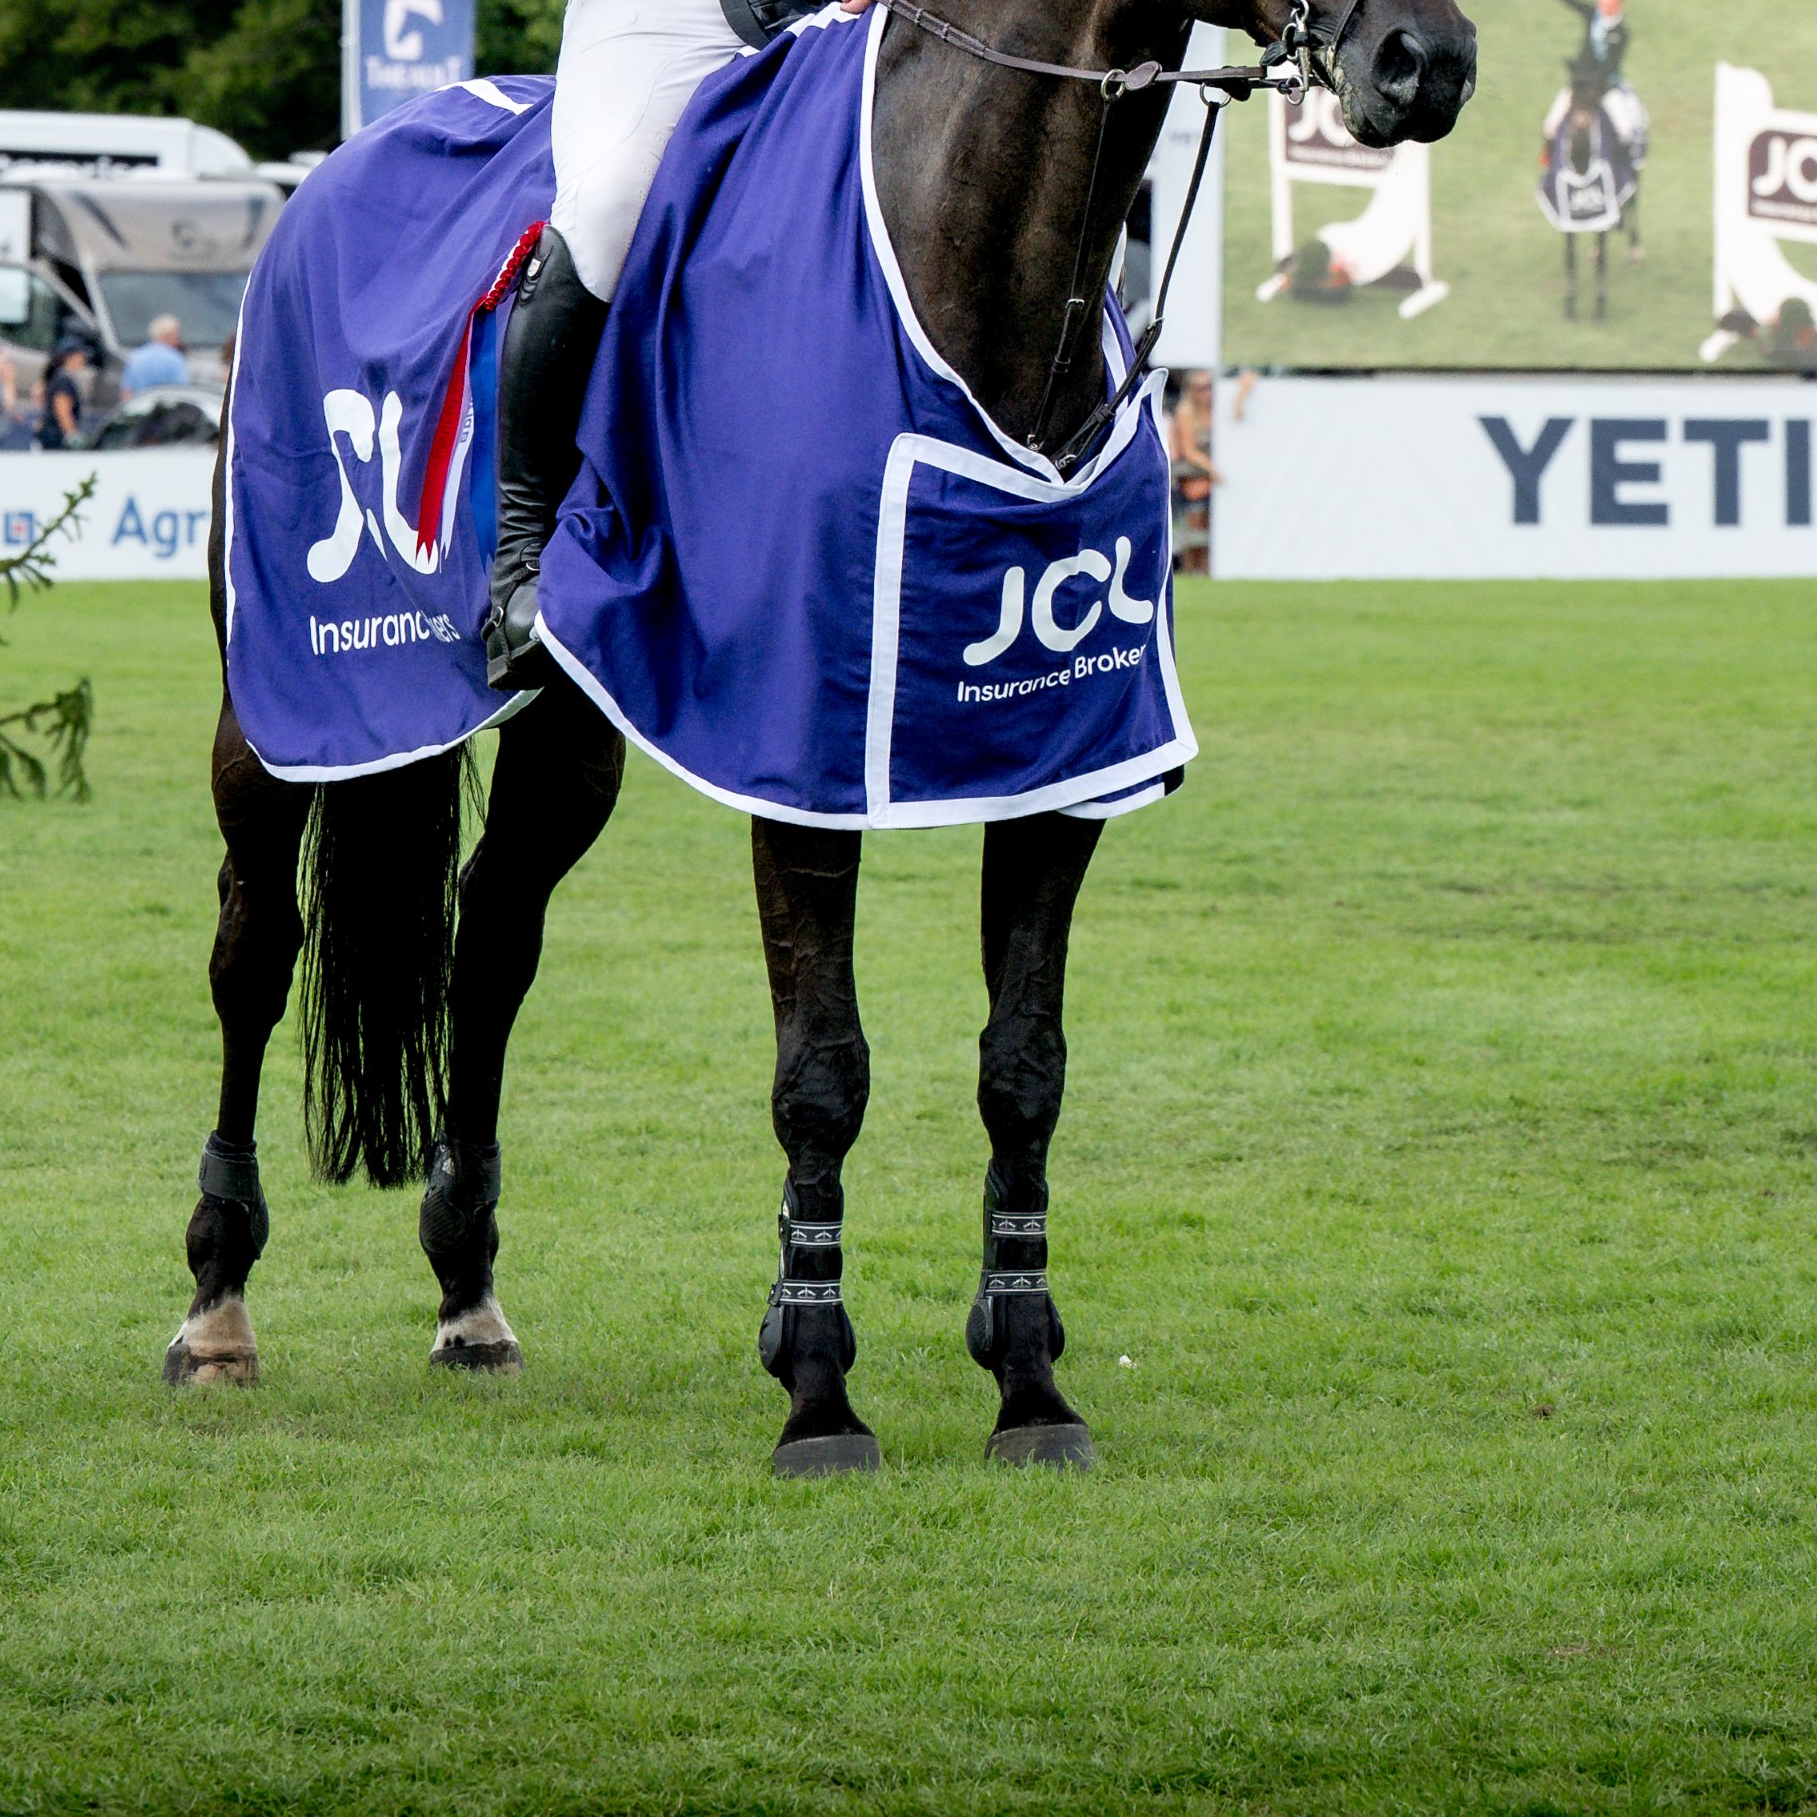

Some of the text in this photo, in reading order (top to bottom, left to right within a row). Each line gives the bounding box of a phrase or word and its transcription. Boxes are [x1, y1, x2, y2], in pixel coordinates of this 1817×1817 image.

[1477, 415, 1814, 528] YETI
[112, 496, 208, 559] Agr
[962, 535, 1154, 666] JCL
[309, 610, 430, 656] Insuranc
[957, 644, 1147, 703] Insurance Broker
